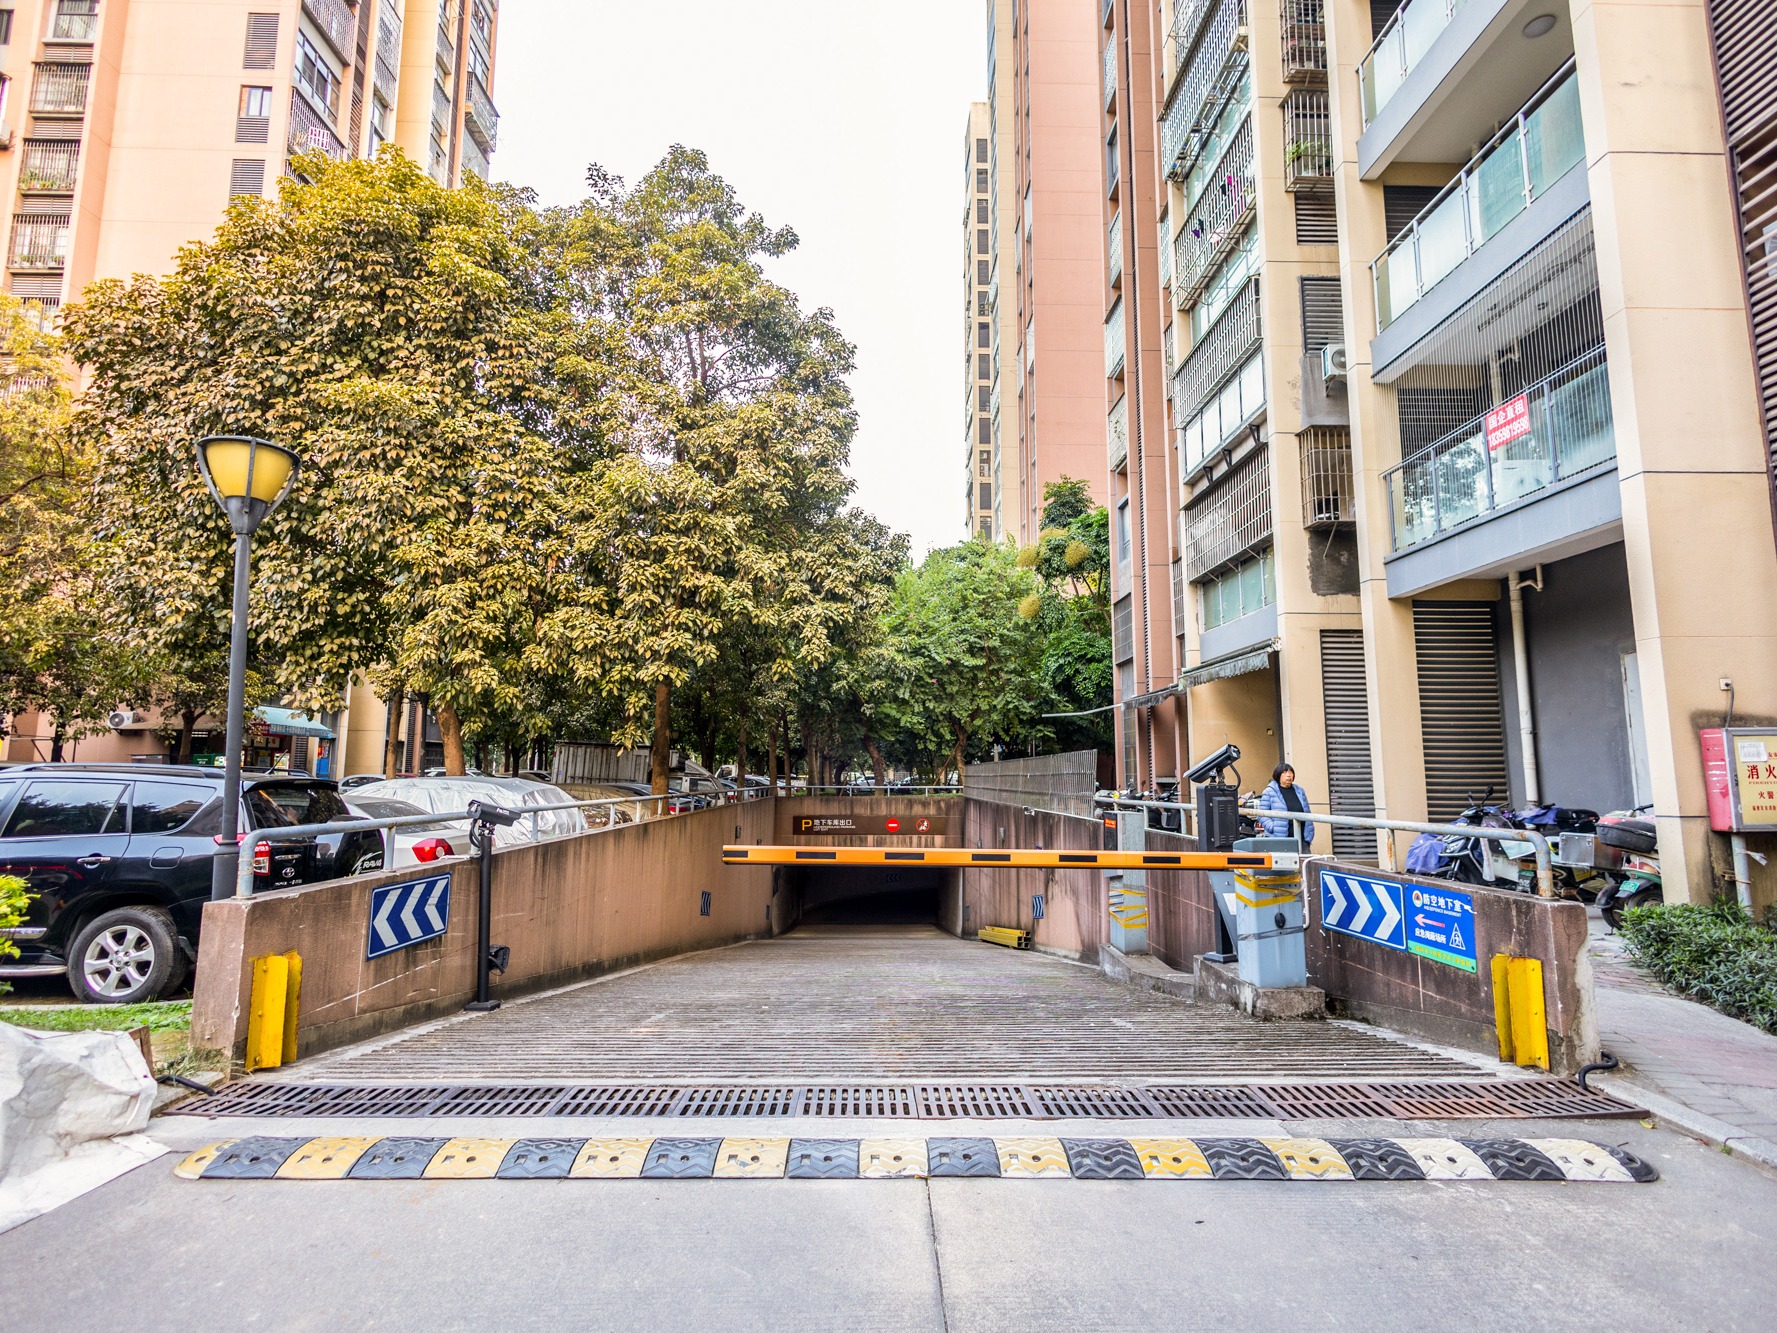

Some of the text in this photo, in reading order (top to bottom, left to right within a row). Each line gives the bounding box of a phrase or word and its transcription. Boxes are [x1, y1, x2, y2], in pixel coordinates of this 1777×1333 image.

[802, 819, 812, 831] P
[363, 859, 382, 868] RAV4
[1423, 893, 1462, 912] 防空地下室
